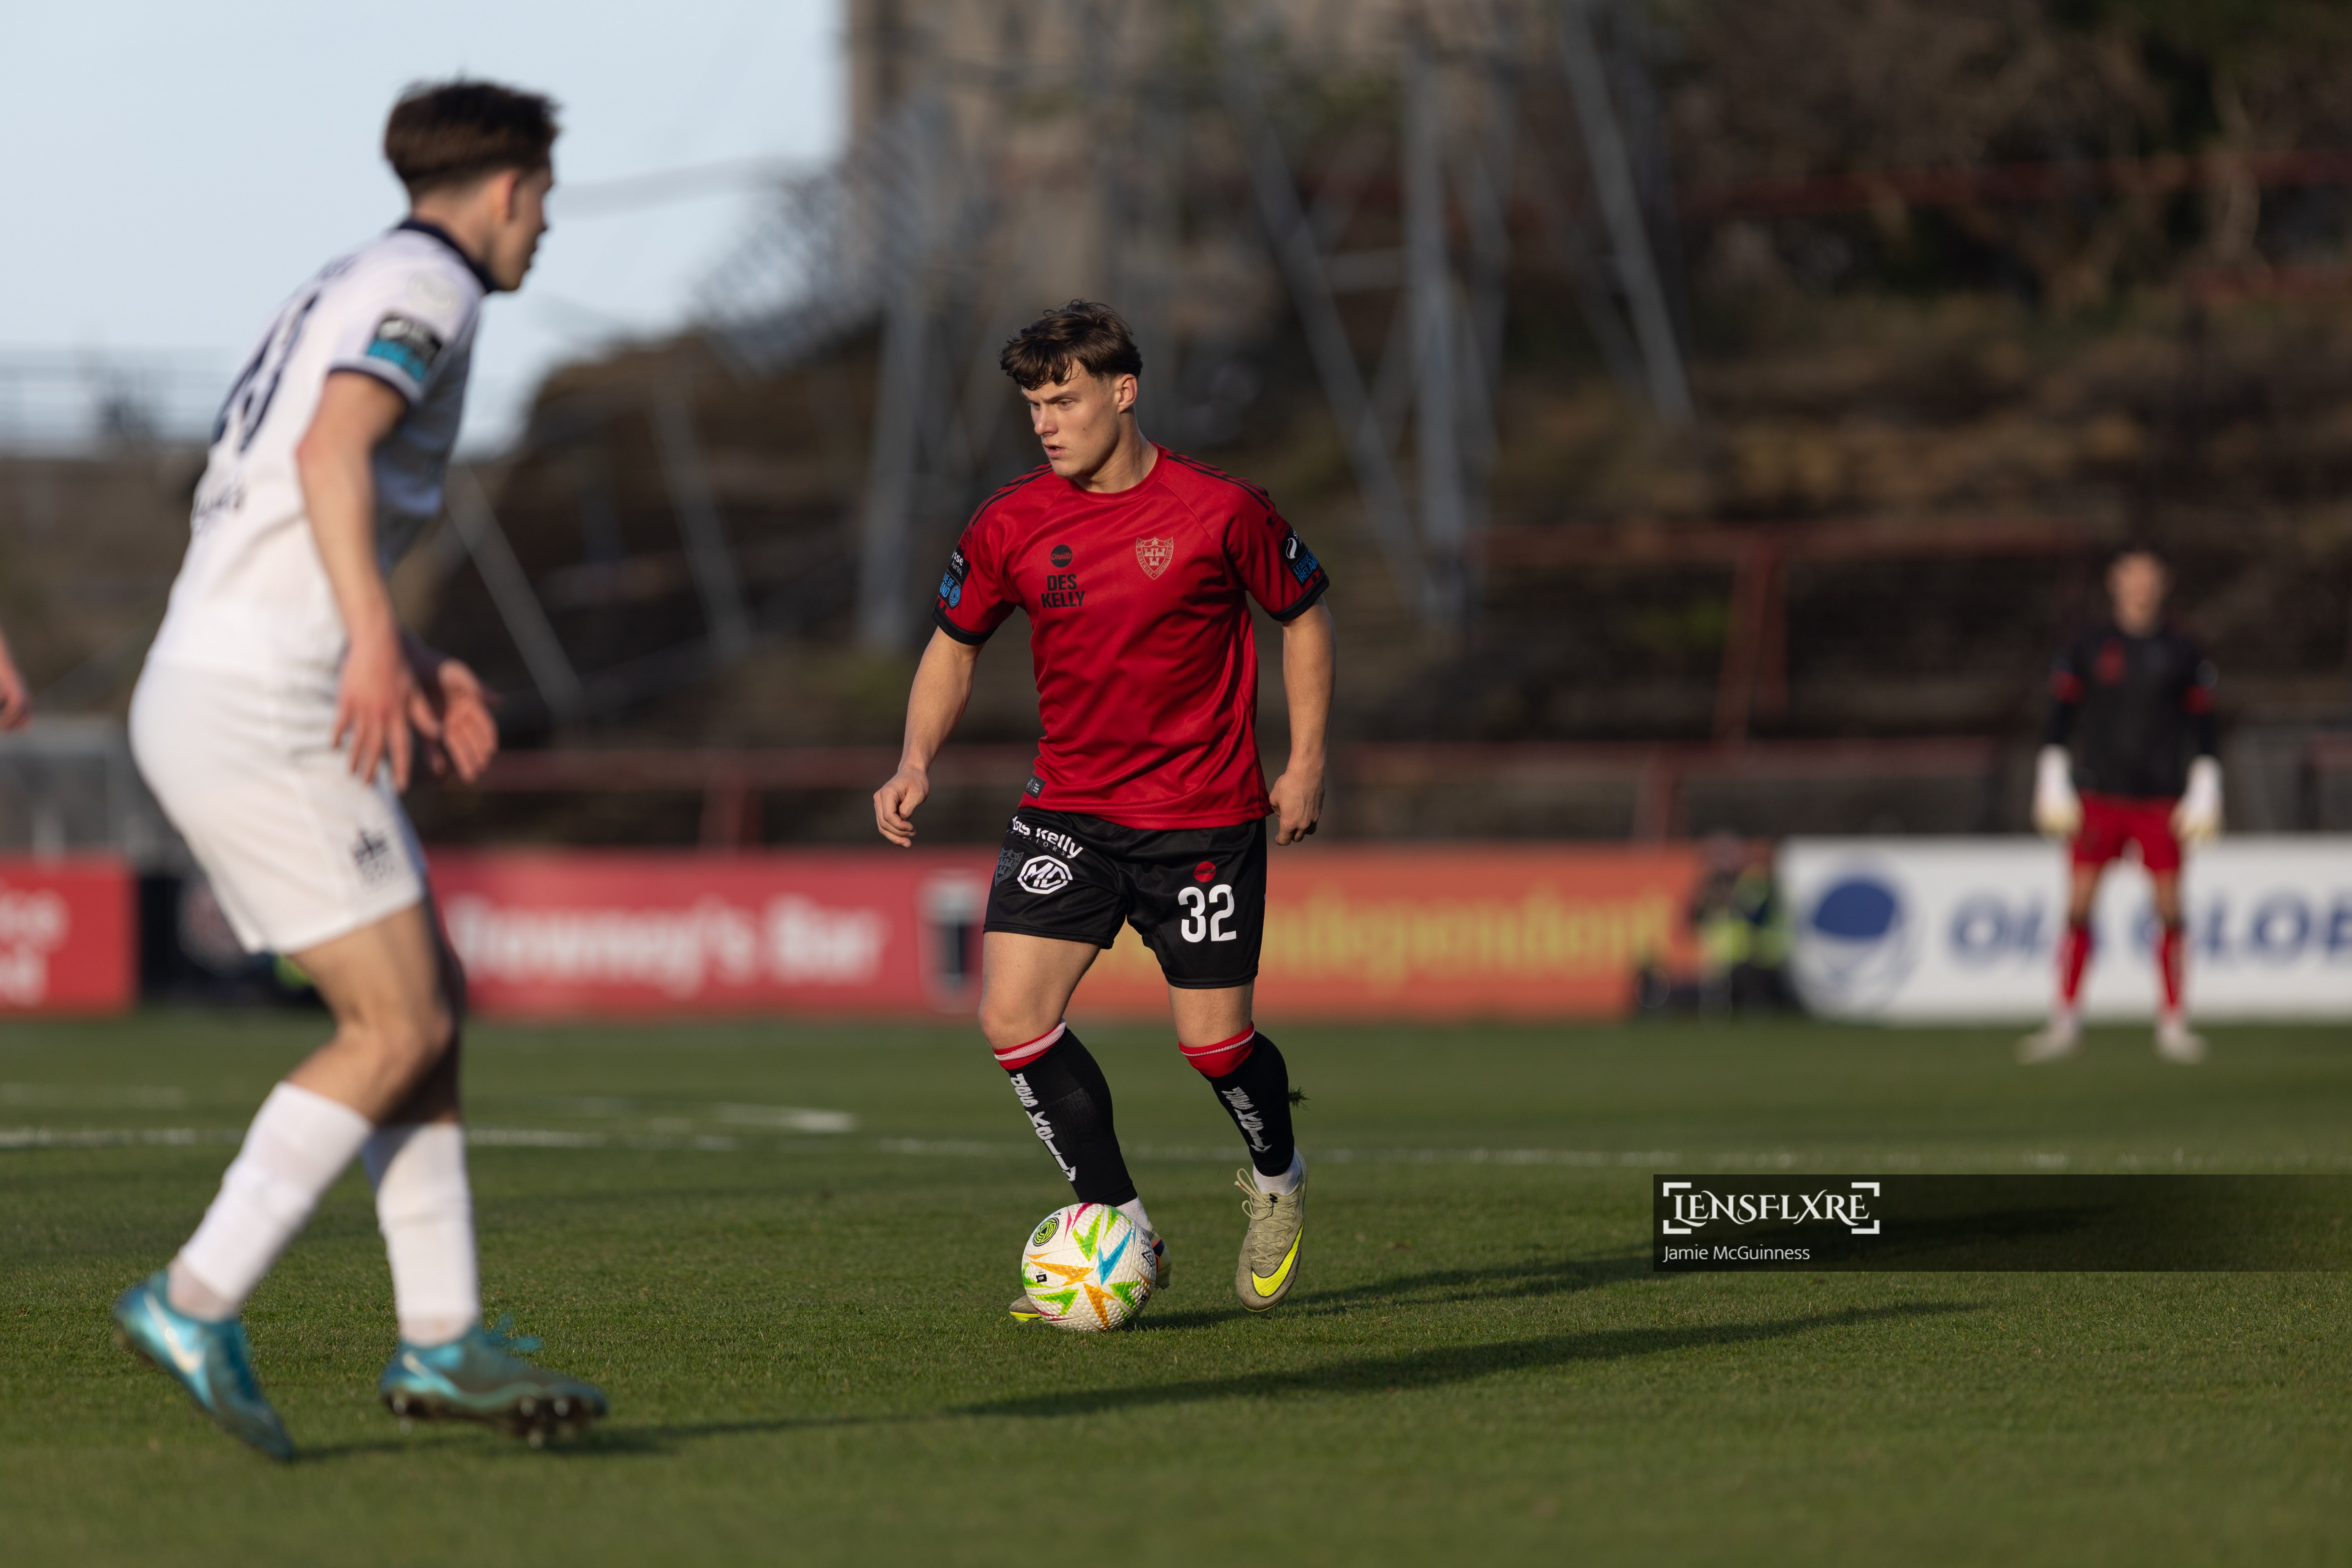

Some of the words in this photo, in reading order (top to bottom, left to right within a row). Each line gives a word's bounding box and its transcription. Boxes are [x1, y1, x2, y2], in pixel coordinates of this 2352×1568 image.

[1137, 550, 1153, 576] BOHEMIAN
[1293, 553, 1312, 575] LEAGUE
[1298, 555, 1318, 583] IRELAN
[1047, 573, 1078, 591] DES
[1041, 591, 1085, 608] KELLY
[1178, 884, 1237, 943] 32
